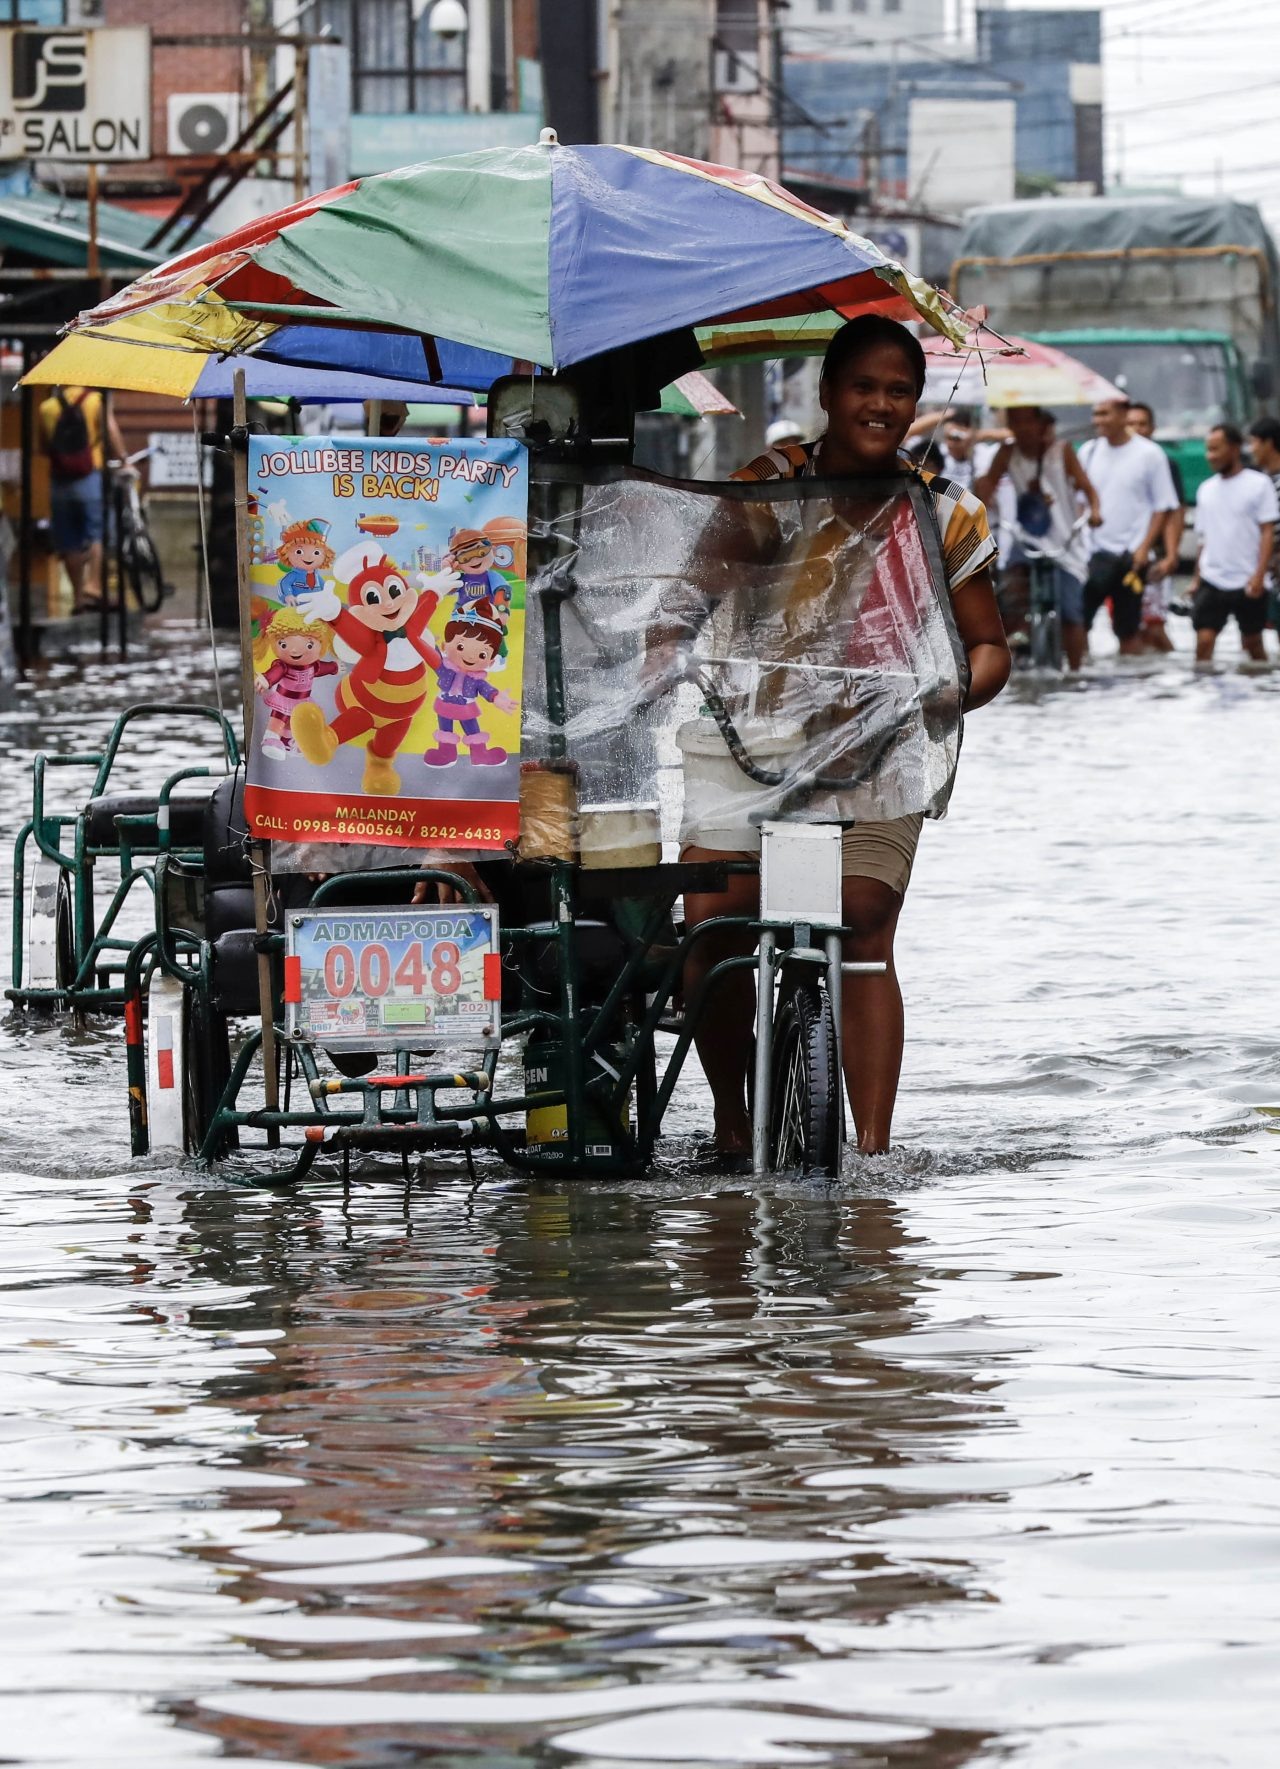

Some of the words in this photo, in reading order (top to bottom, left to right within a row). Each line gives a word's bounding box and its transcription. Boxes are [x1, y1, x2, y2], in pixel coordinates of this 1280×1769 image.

[23, 118, 140, 152] SALON
[257, 450, 364, 478] JOLLIBEE
[371, 451, 431, 475] KIDS
[439, 456, 518, 488] PARTY
[333, 474, 354, 497] IS
[362, 474, 440, 501] BACK!
[255, 814, 288, 830] CALL:
[293, 819, 403, 837] 0998-8600564
[420, 826, 501, 840] 8242-6433
[335, 807, 417, 822] MALANDAY
[312, 919, 473, 942] ADMAPODA
[323, 941, 462, 998] 0048
[460, 1002, 489, 1013] 2021
